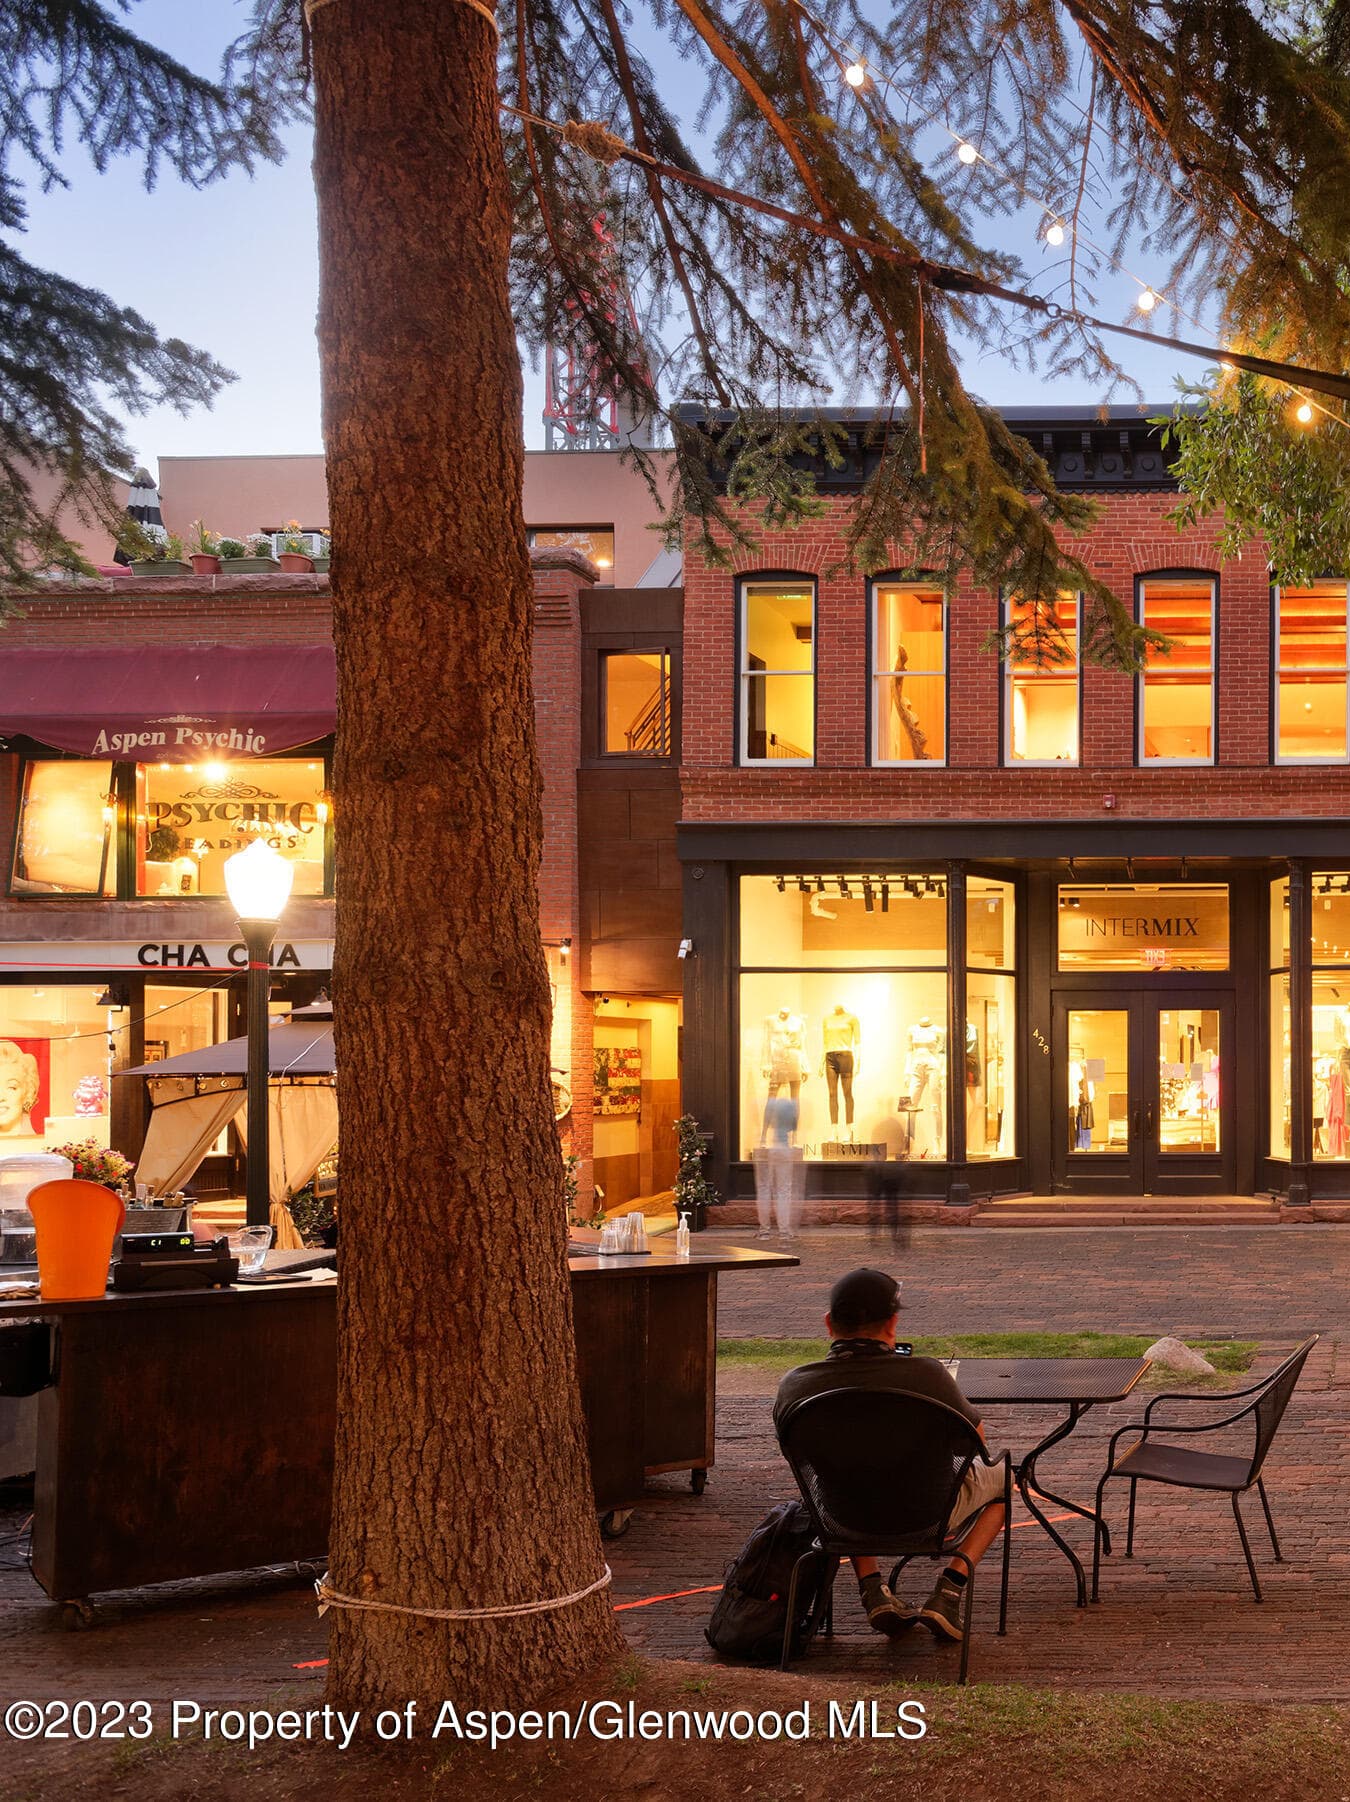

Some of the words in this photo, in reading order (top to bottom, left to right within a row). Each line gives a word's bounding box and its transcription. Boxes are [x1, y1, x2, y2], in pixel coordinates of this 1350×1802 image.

[91, 729, 166, 755] Aspen
[175, 727, 266, 755] Psychic
[146, 802, 314, 834] PSYCHIC
[168, 835, 297, 849] EADIGS
[1086, 917, 1200, 937] INTERMIX
[137, 943, 211, 967] CHA
[1032, 1028, 1050, 1055] 428
[803, 1143, 882, 1156] INERMIX
